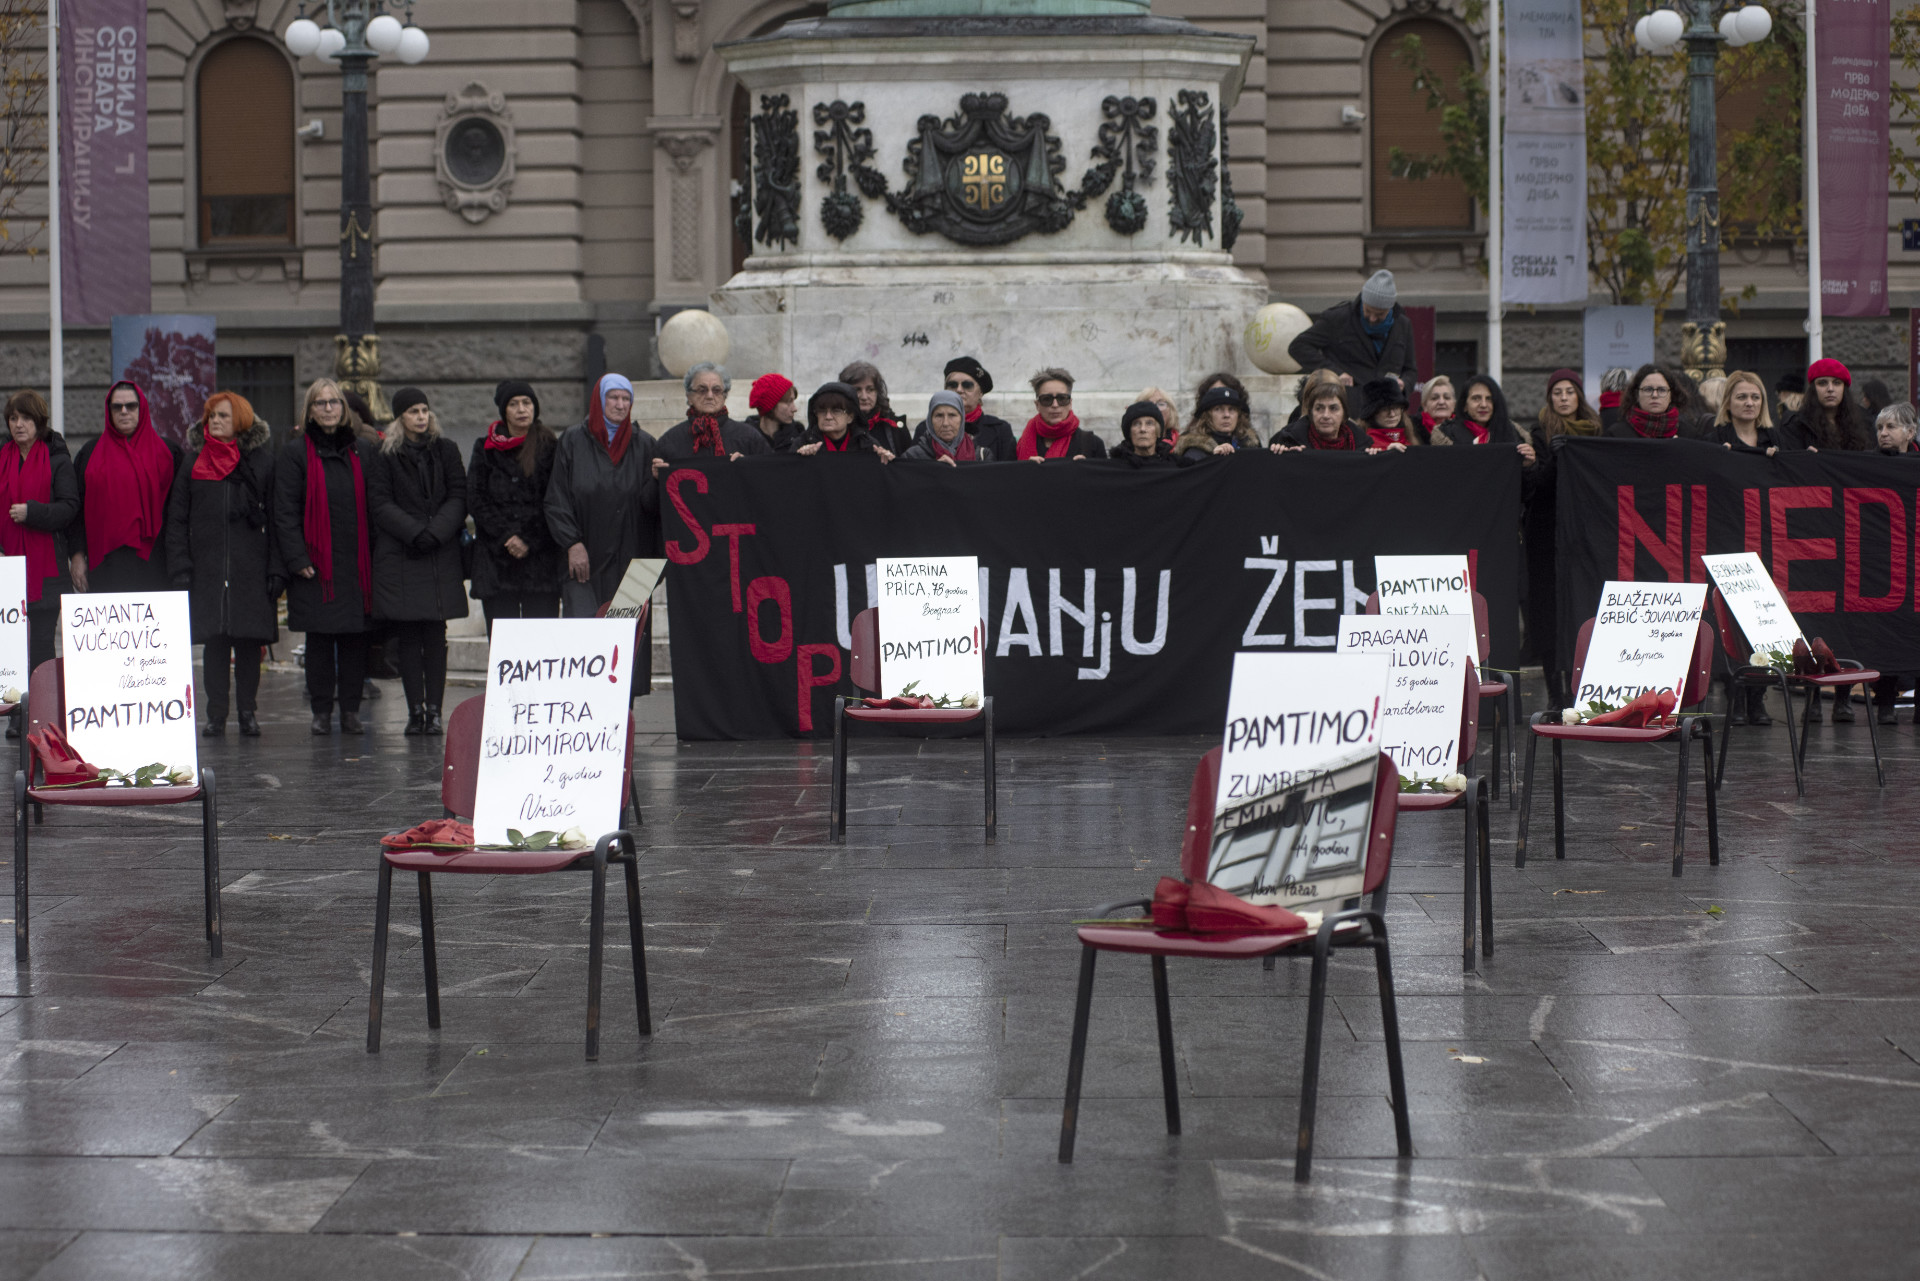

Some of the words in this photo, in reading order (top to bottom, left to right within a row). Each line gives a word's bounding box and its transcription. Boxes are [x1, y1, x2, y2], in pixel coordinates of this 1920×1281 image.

[94, 26, 116, 134] СТВАРА
[115, 26, 137, 136] СРБИЈА
[1844, 72, 1870, 84] ПРВО
[1830, 88, 1880, 102] МОДЕРНО
[1843, 104, 1870, 117] ДОБА
[73, 27, 95, 231] ИНСПИРАЦИЈУ
[1511, 255, 1558, 266] СРБИЈА
[1511, 266, 1557, 278] СТВАРА
[886, 562, 948, 577] KATARINA
[885, 580, 931, 598] PRICA,
[1379, 569, 1469, 597] PAMTIMO!
[1606, 589, 1682, 607] BLAŽENKA
[0, 599, 27, 624] O!
[922, 602, 962, 620] Beograd
[881, 625, 979, 662] PAMTIMO!
[1347, 629, 1428, 648] DRAGANA
[497, 644, 619, 686] PAMTIMO!
[1388, 643, 1454, 667] ILOVIĆ,
[1395, 676, 1408, 687] 55
[1409, 677, 1438, 691] godina
[67, 684, 192, 732] PAMTIMO!
[512, 701, 593, 724] PETRA
[1383, 699, 1444, 716] anđelovac
[1228, 695, 1380, 753] PAMTIMO!
[1384, 740, 1454, 767] TIMO!
[543, 764, 555, 784] 2
